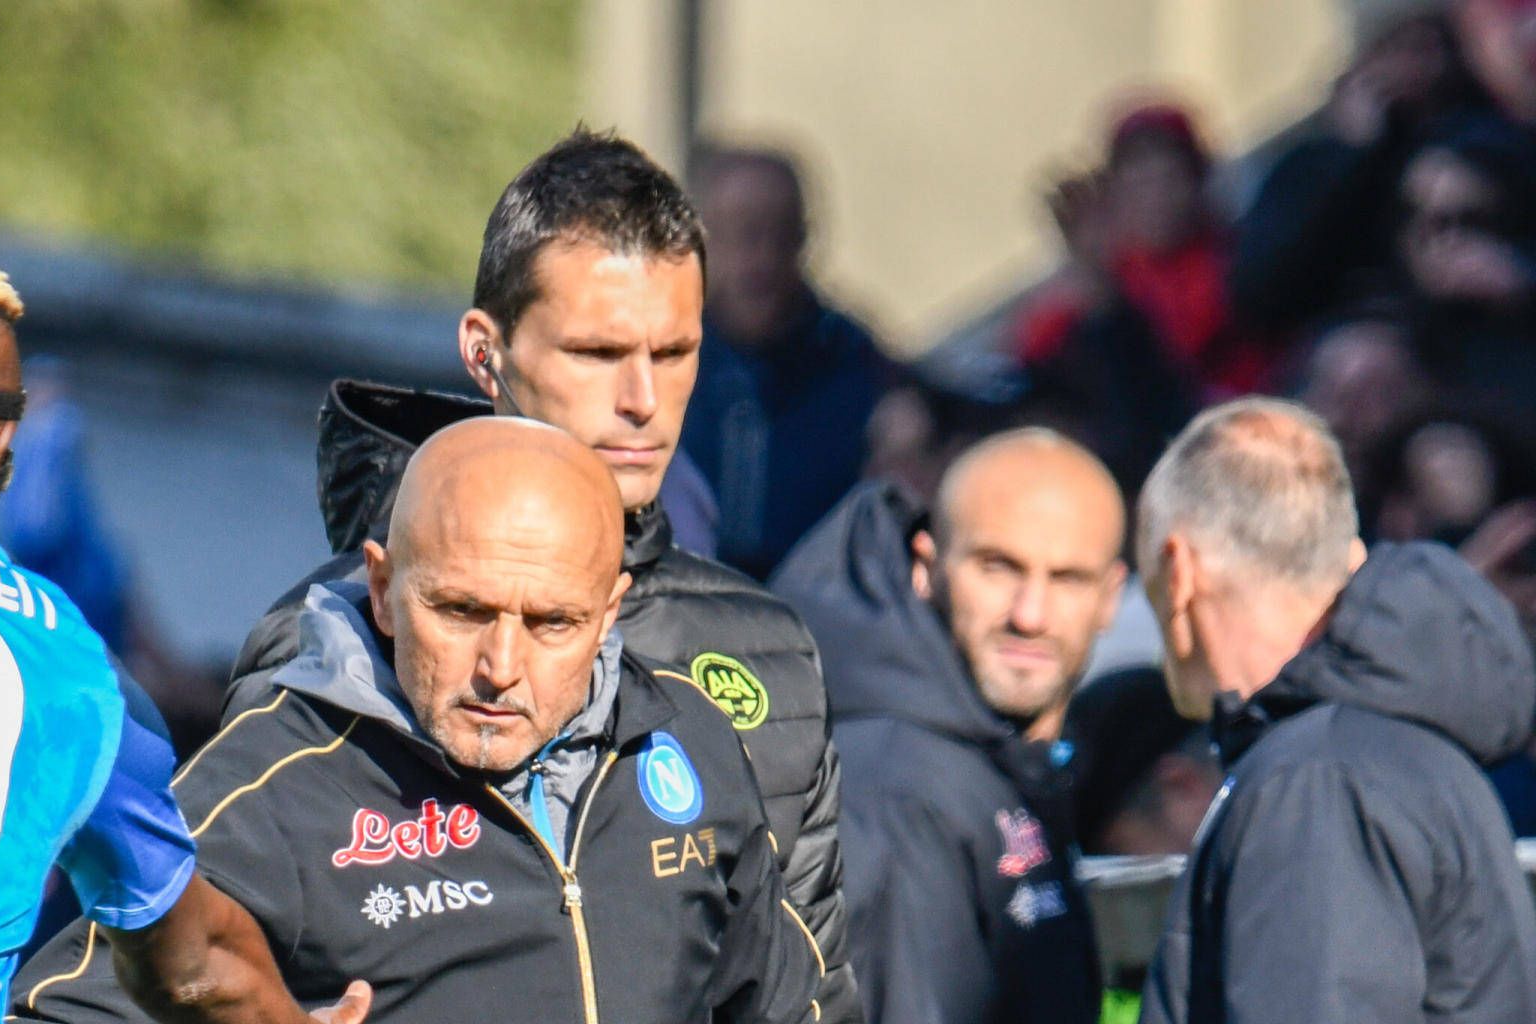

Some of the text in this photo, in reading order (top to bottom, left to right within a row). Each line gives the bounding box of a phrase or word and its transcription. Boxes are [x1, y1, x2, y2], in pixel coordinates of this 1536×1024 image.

[653, 757, 691, 800] N
[332, 797, 481, 868] Lete
[404, 879, 494, 919] MSC
